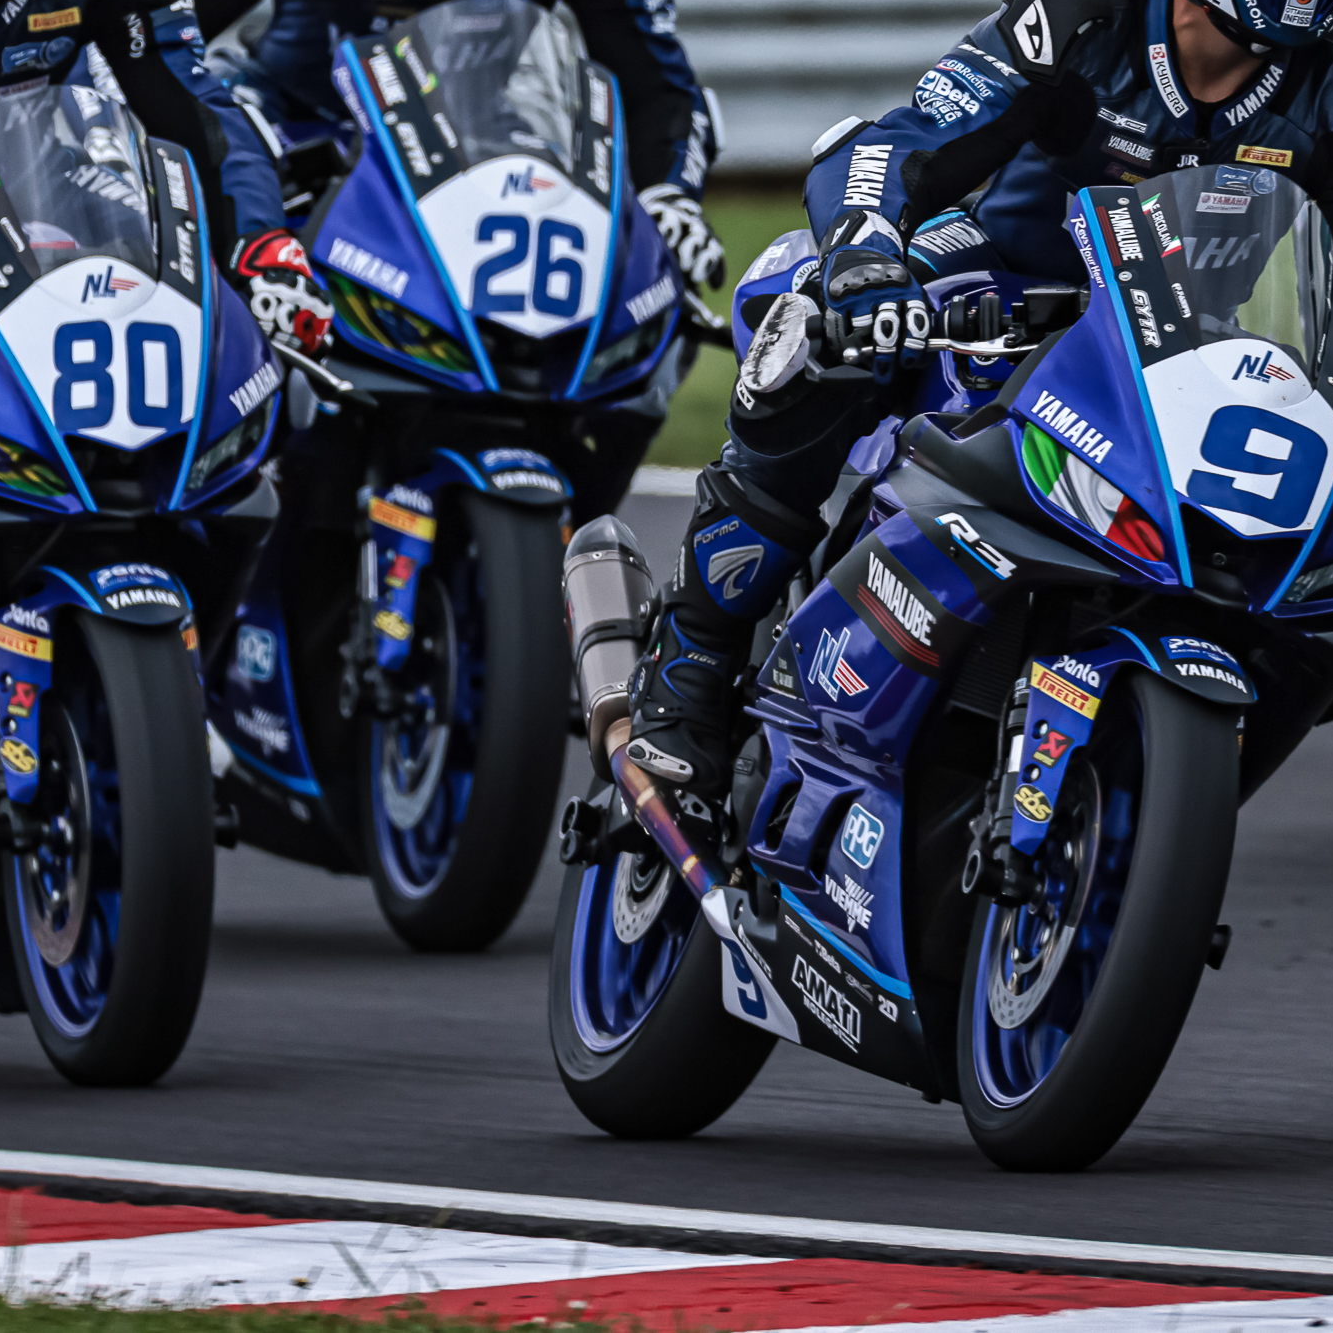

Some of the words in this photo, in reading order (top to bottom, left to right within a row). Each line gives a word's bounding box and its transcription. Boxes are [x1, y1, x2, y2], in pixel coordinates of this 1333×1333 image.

[933, 75, 981, 117] Beta
[947, 59, 992, 98] GBRacing
[1224, 64, 1284, 128] YAMAHA
[843, 144, 894, 207] YAMAHA
[1108, 135, 1155, 162] YAMALUBE
[1240, 147, 1289, 165] PIRELLI
[1070, 213, 1090, 247] Revs
[1080, 243, 1096, 266] Your
[1108, 207, 1142, 261] YAMALUBE
[81, 265, 116, 303] NL
[473, 215, 584, 318] 26
[1130, 288, 1162, 348] GYTR
[54, 320, 183, 430] 80
[229, 362, 281, 417] YAMAHA
[1232, 350, 1273, 380] NL
[1030, 390, 1113, 464] YAMAHA
[1186, 404, 1328, 529] 9
[107, 589, 181, 610] YAMAHA
[867, 552, 934, 646] YAMALUBE
[1037, 671, 1089, 712] PIRELLI
[1175, 664, 1247, 694] YAMAHA
[844, 811, 879, 860] PPG
[824, 874, 873, 931] VUEMME
[792, 954, 861, 1044] AMATI
